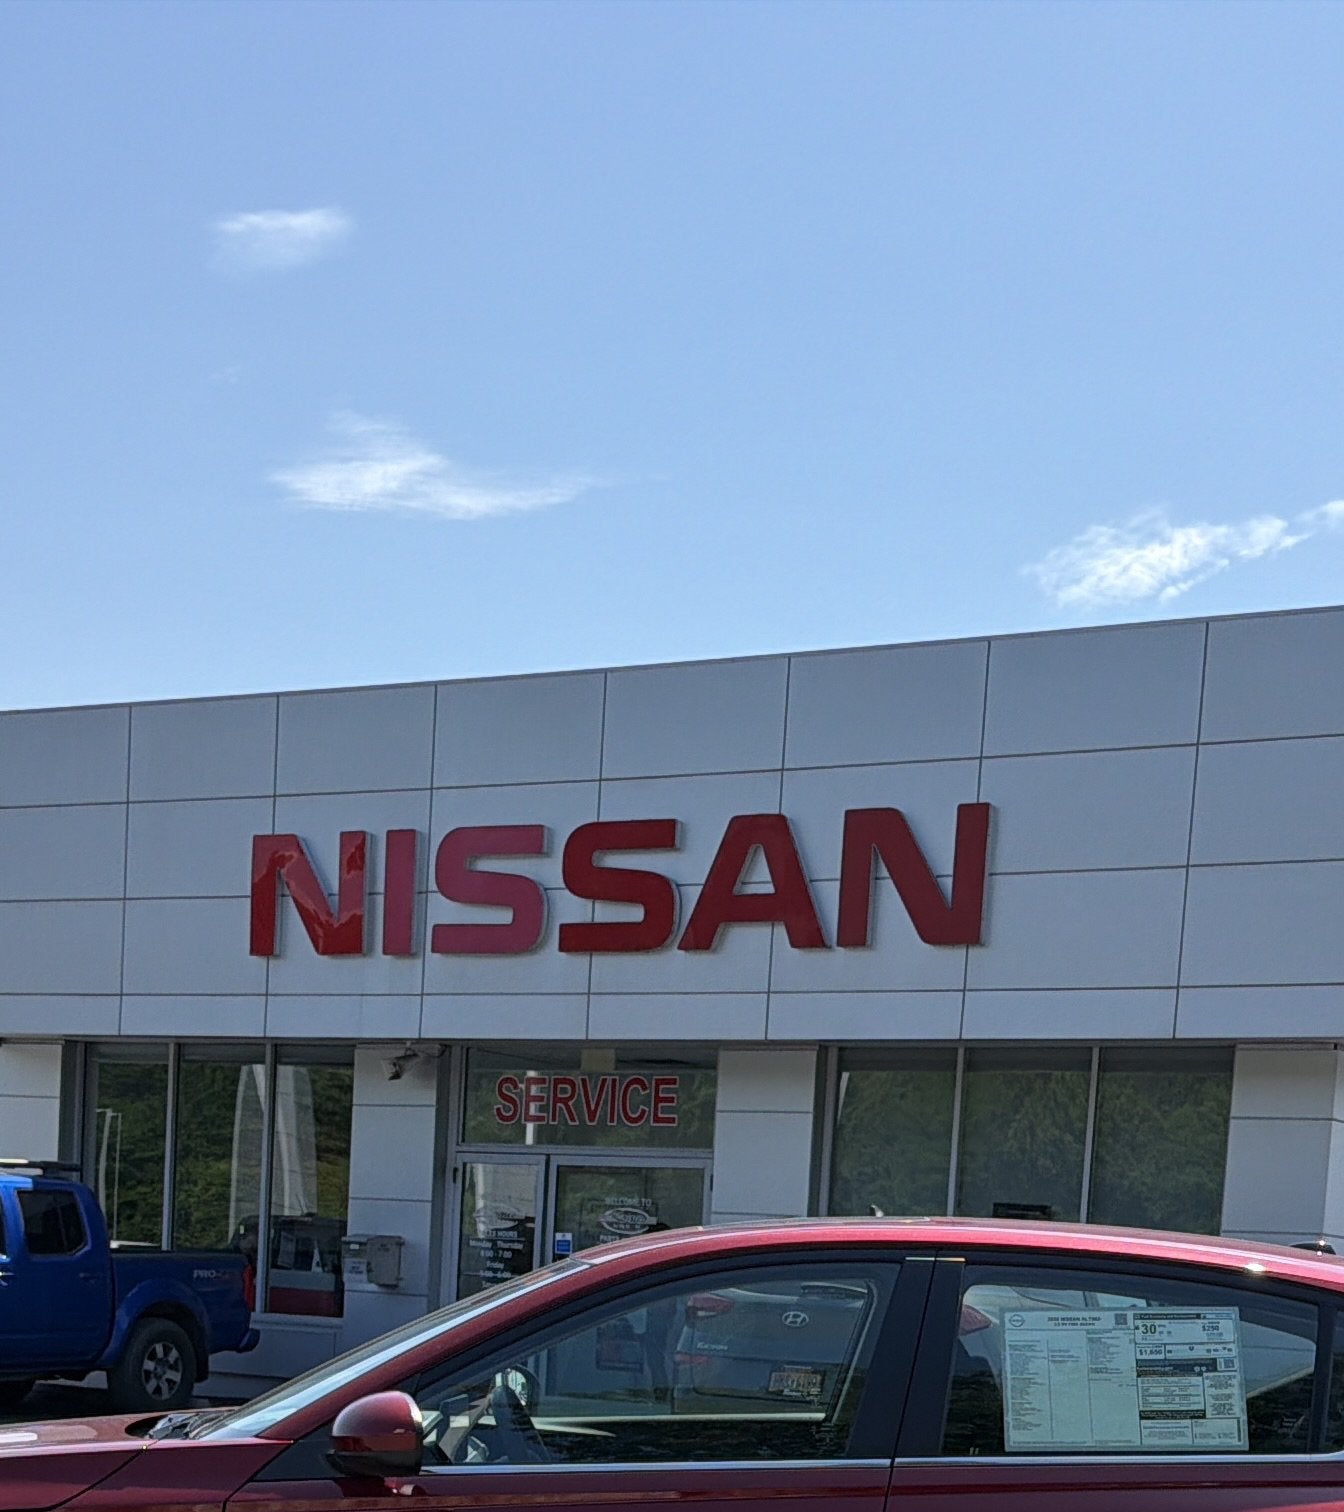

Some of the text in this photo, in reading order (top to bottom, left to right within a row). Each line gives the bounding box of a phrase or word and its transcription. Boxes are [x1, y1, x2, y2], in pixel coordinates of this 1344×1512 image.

[250, 803, 990, 956] NISSAN
[494, 1075, 679, 1126] SERVICE
[641, 1198, 652, 1207] TO
[1141, 1324, 1156, 1334] 30
